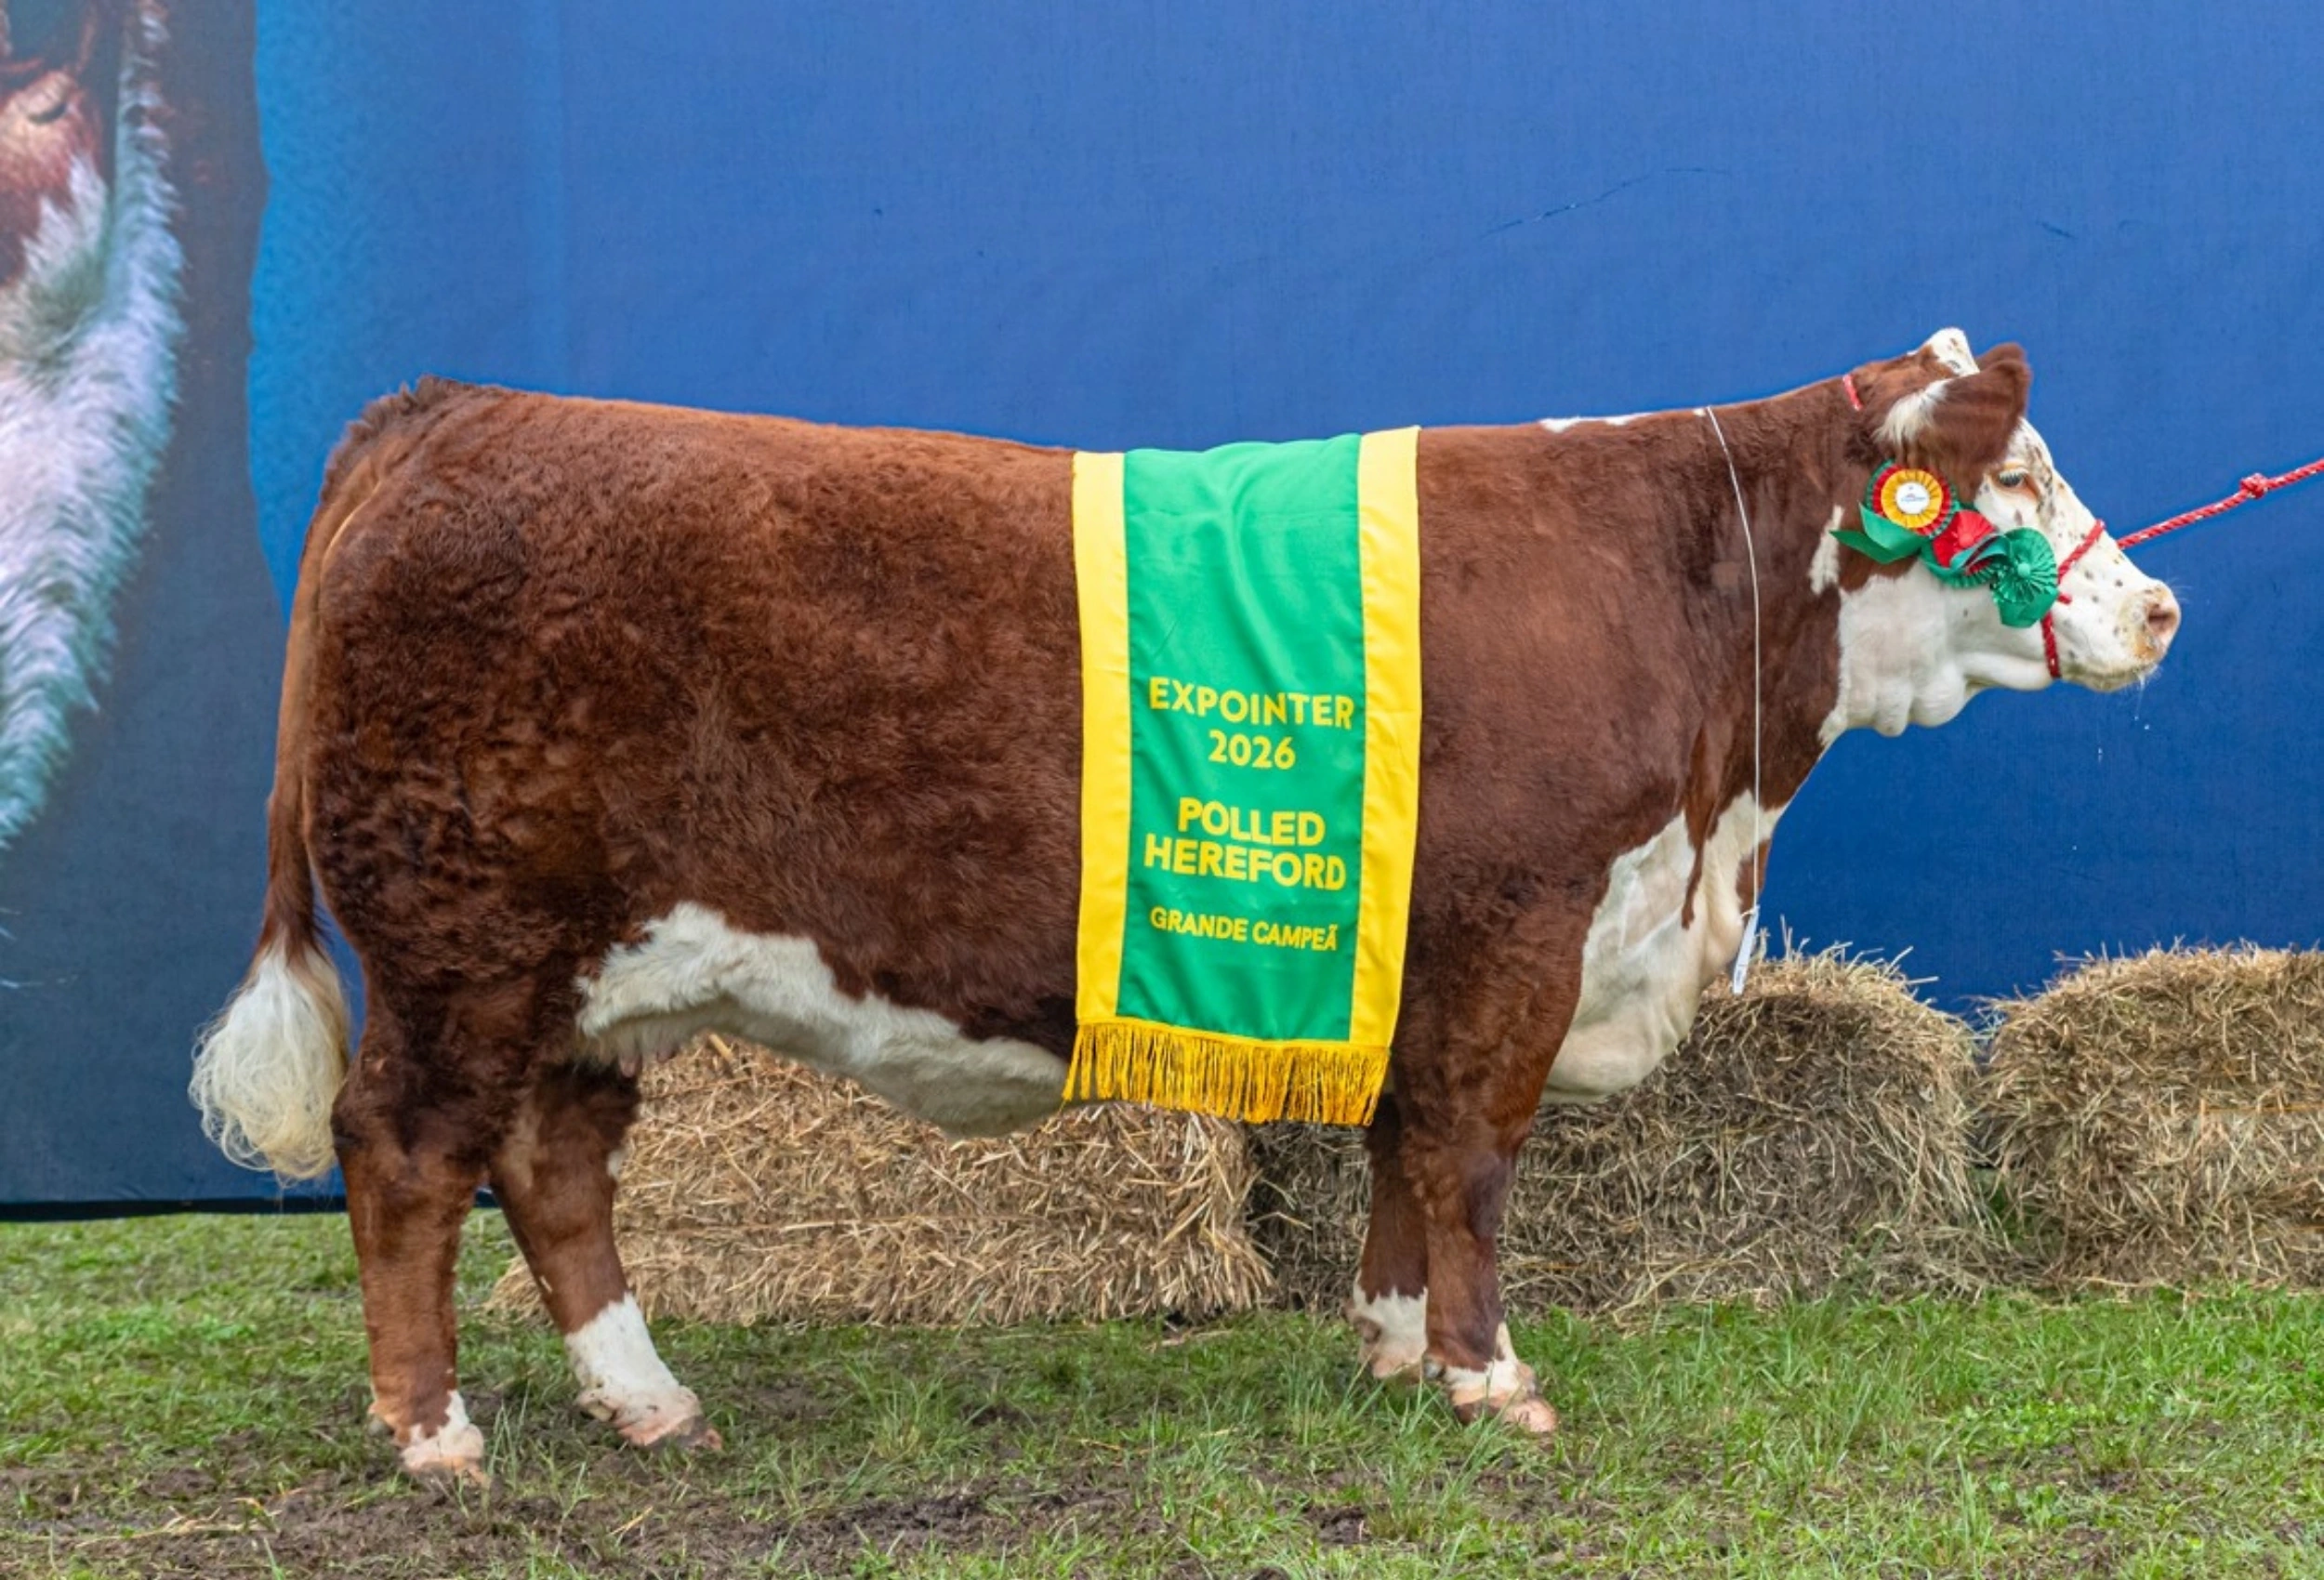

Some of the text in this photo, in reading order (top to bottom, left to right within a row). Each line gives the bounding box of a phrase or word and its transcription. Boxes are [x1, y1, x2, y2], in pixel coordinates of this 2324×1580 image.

[1149, 677, 1354, 729] EXPOINTER
[1208, 729, 1296, 770] 2026
[1178, 797, 1326, 847] POLLED
[1143, 833, 1346, 890] HEREFORD
[1150, 906, 1248, 941] GRANDE
